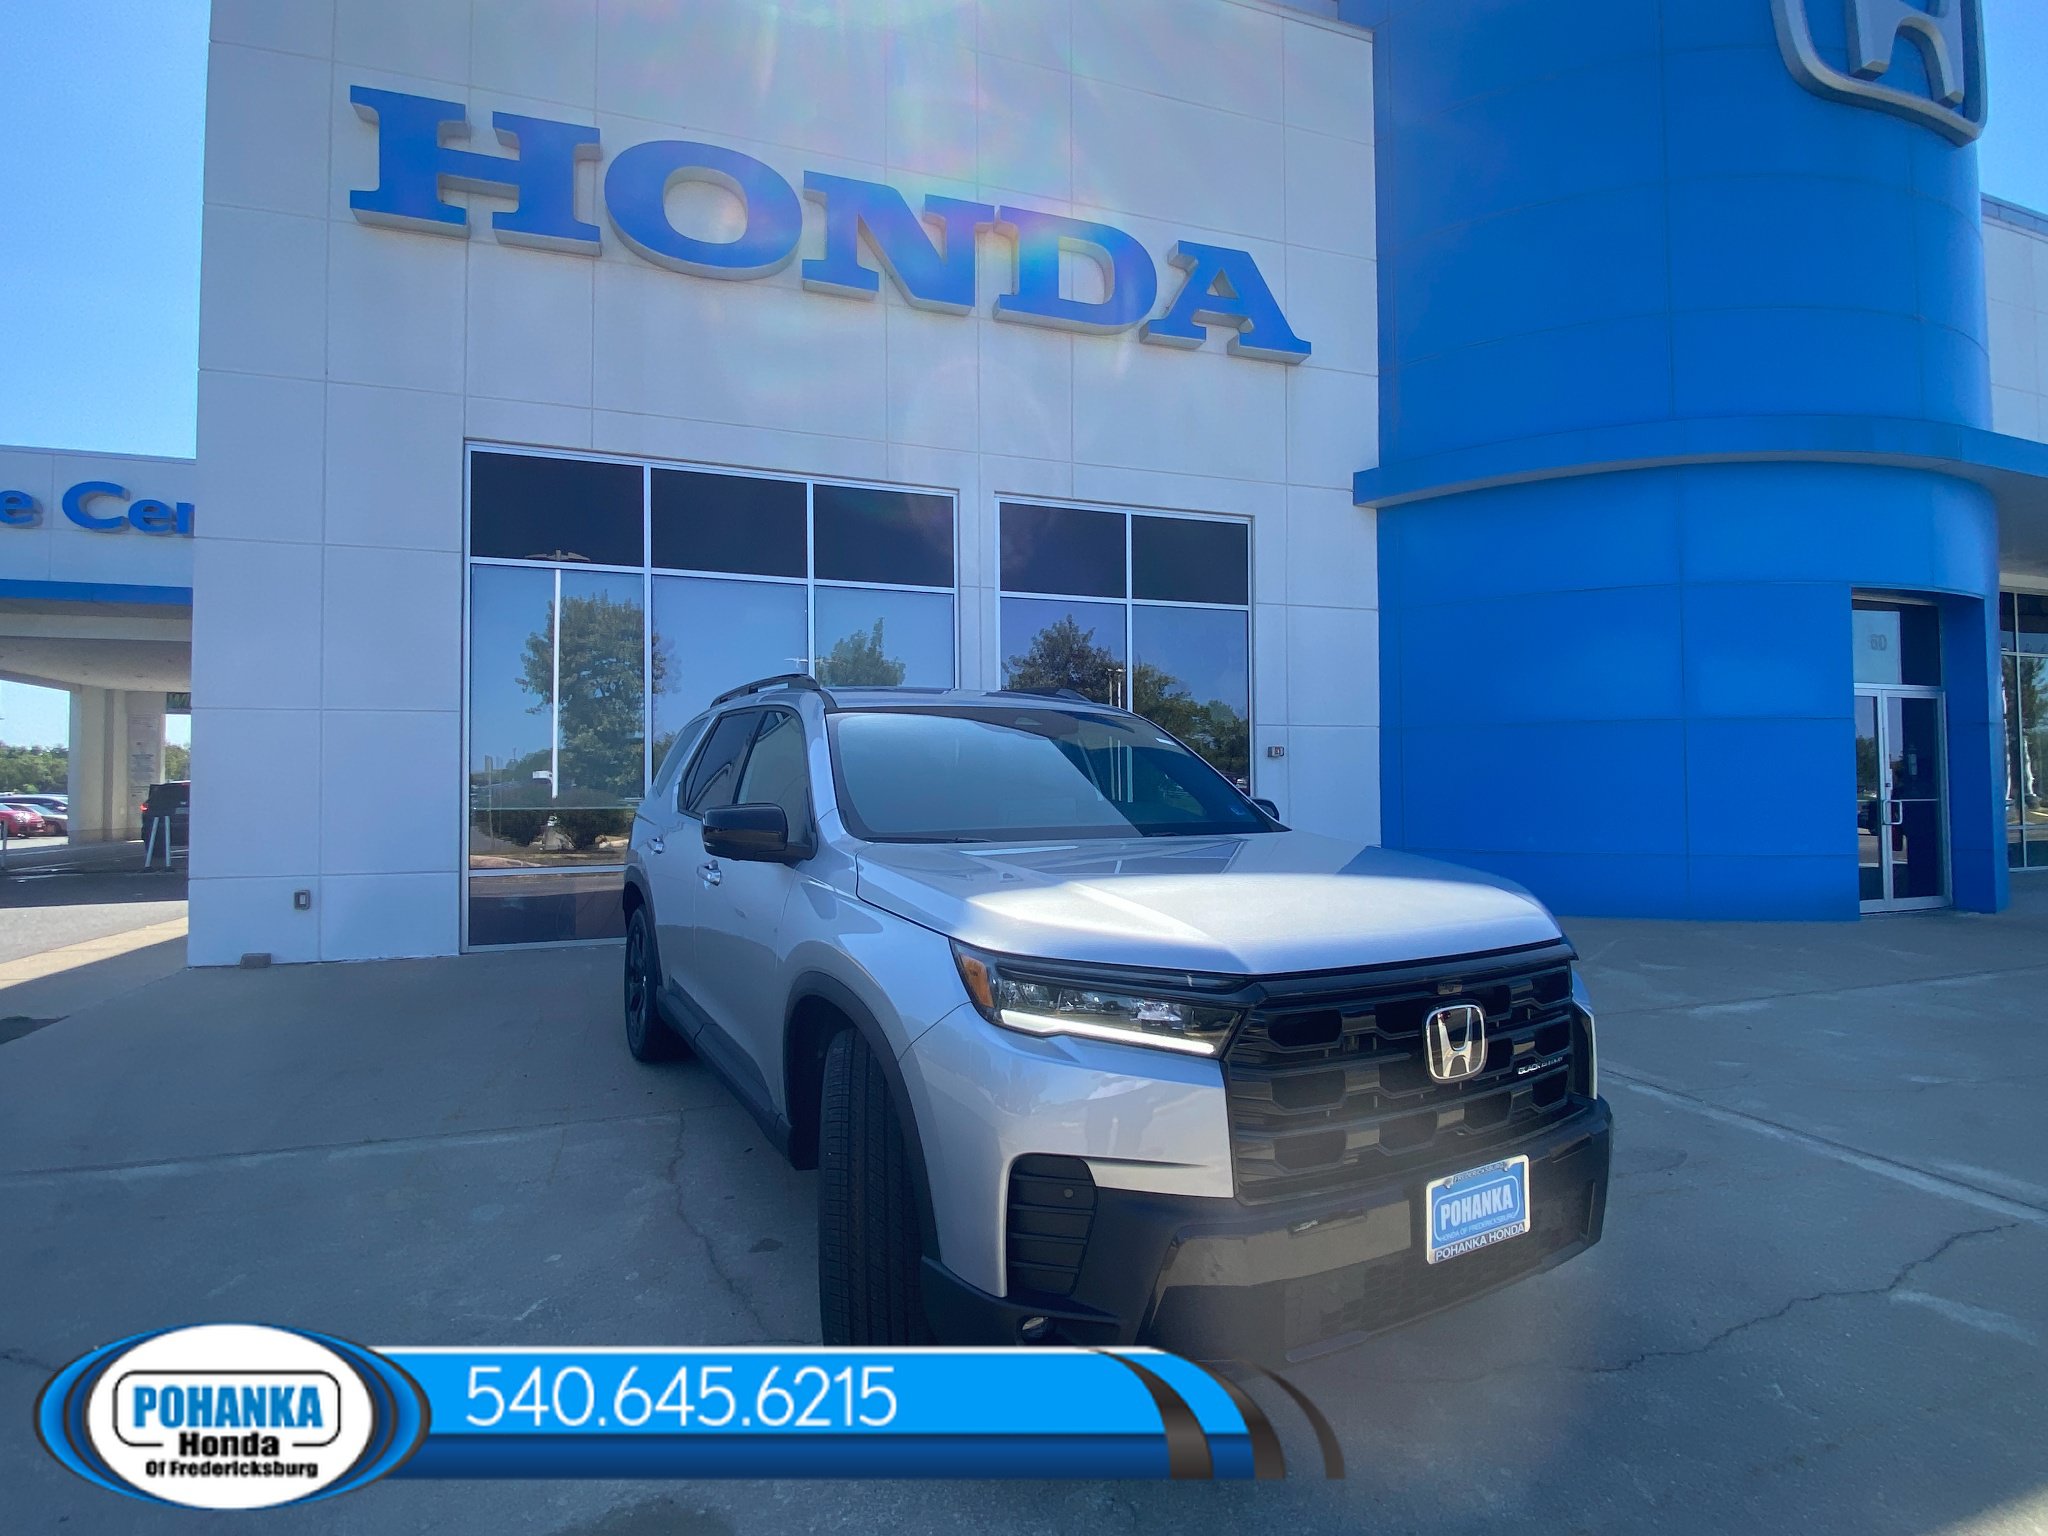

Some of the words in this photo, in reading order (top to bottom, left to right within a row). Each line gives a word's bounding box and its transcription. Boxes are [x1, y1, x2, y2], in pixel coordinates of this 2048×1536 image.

[349, 85, 1312, 364] HONDA
[1440, 1184, 1514, 1231] POHANKA
[1435, 1236, 1487, 1261] POHANKA
[1488, 1223, 1525, 1242] HONDA
